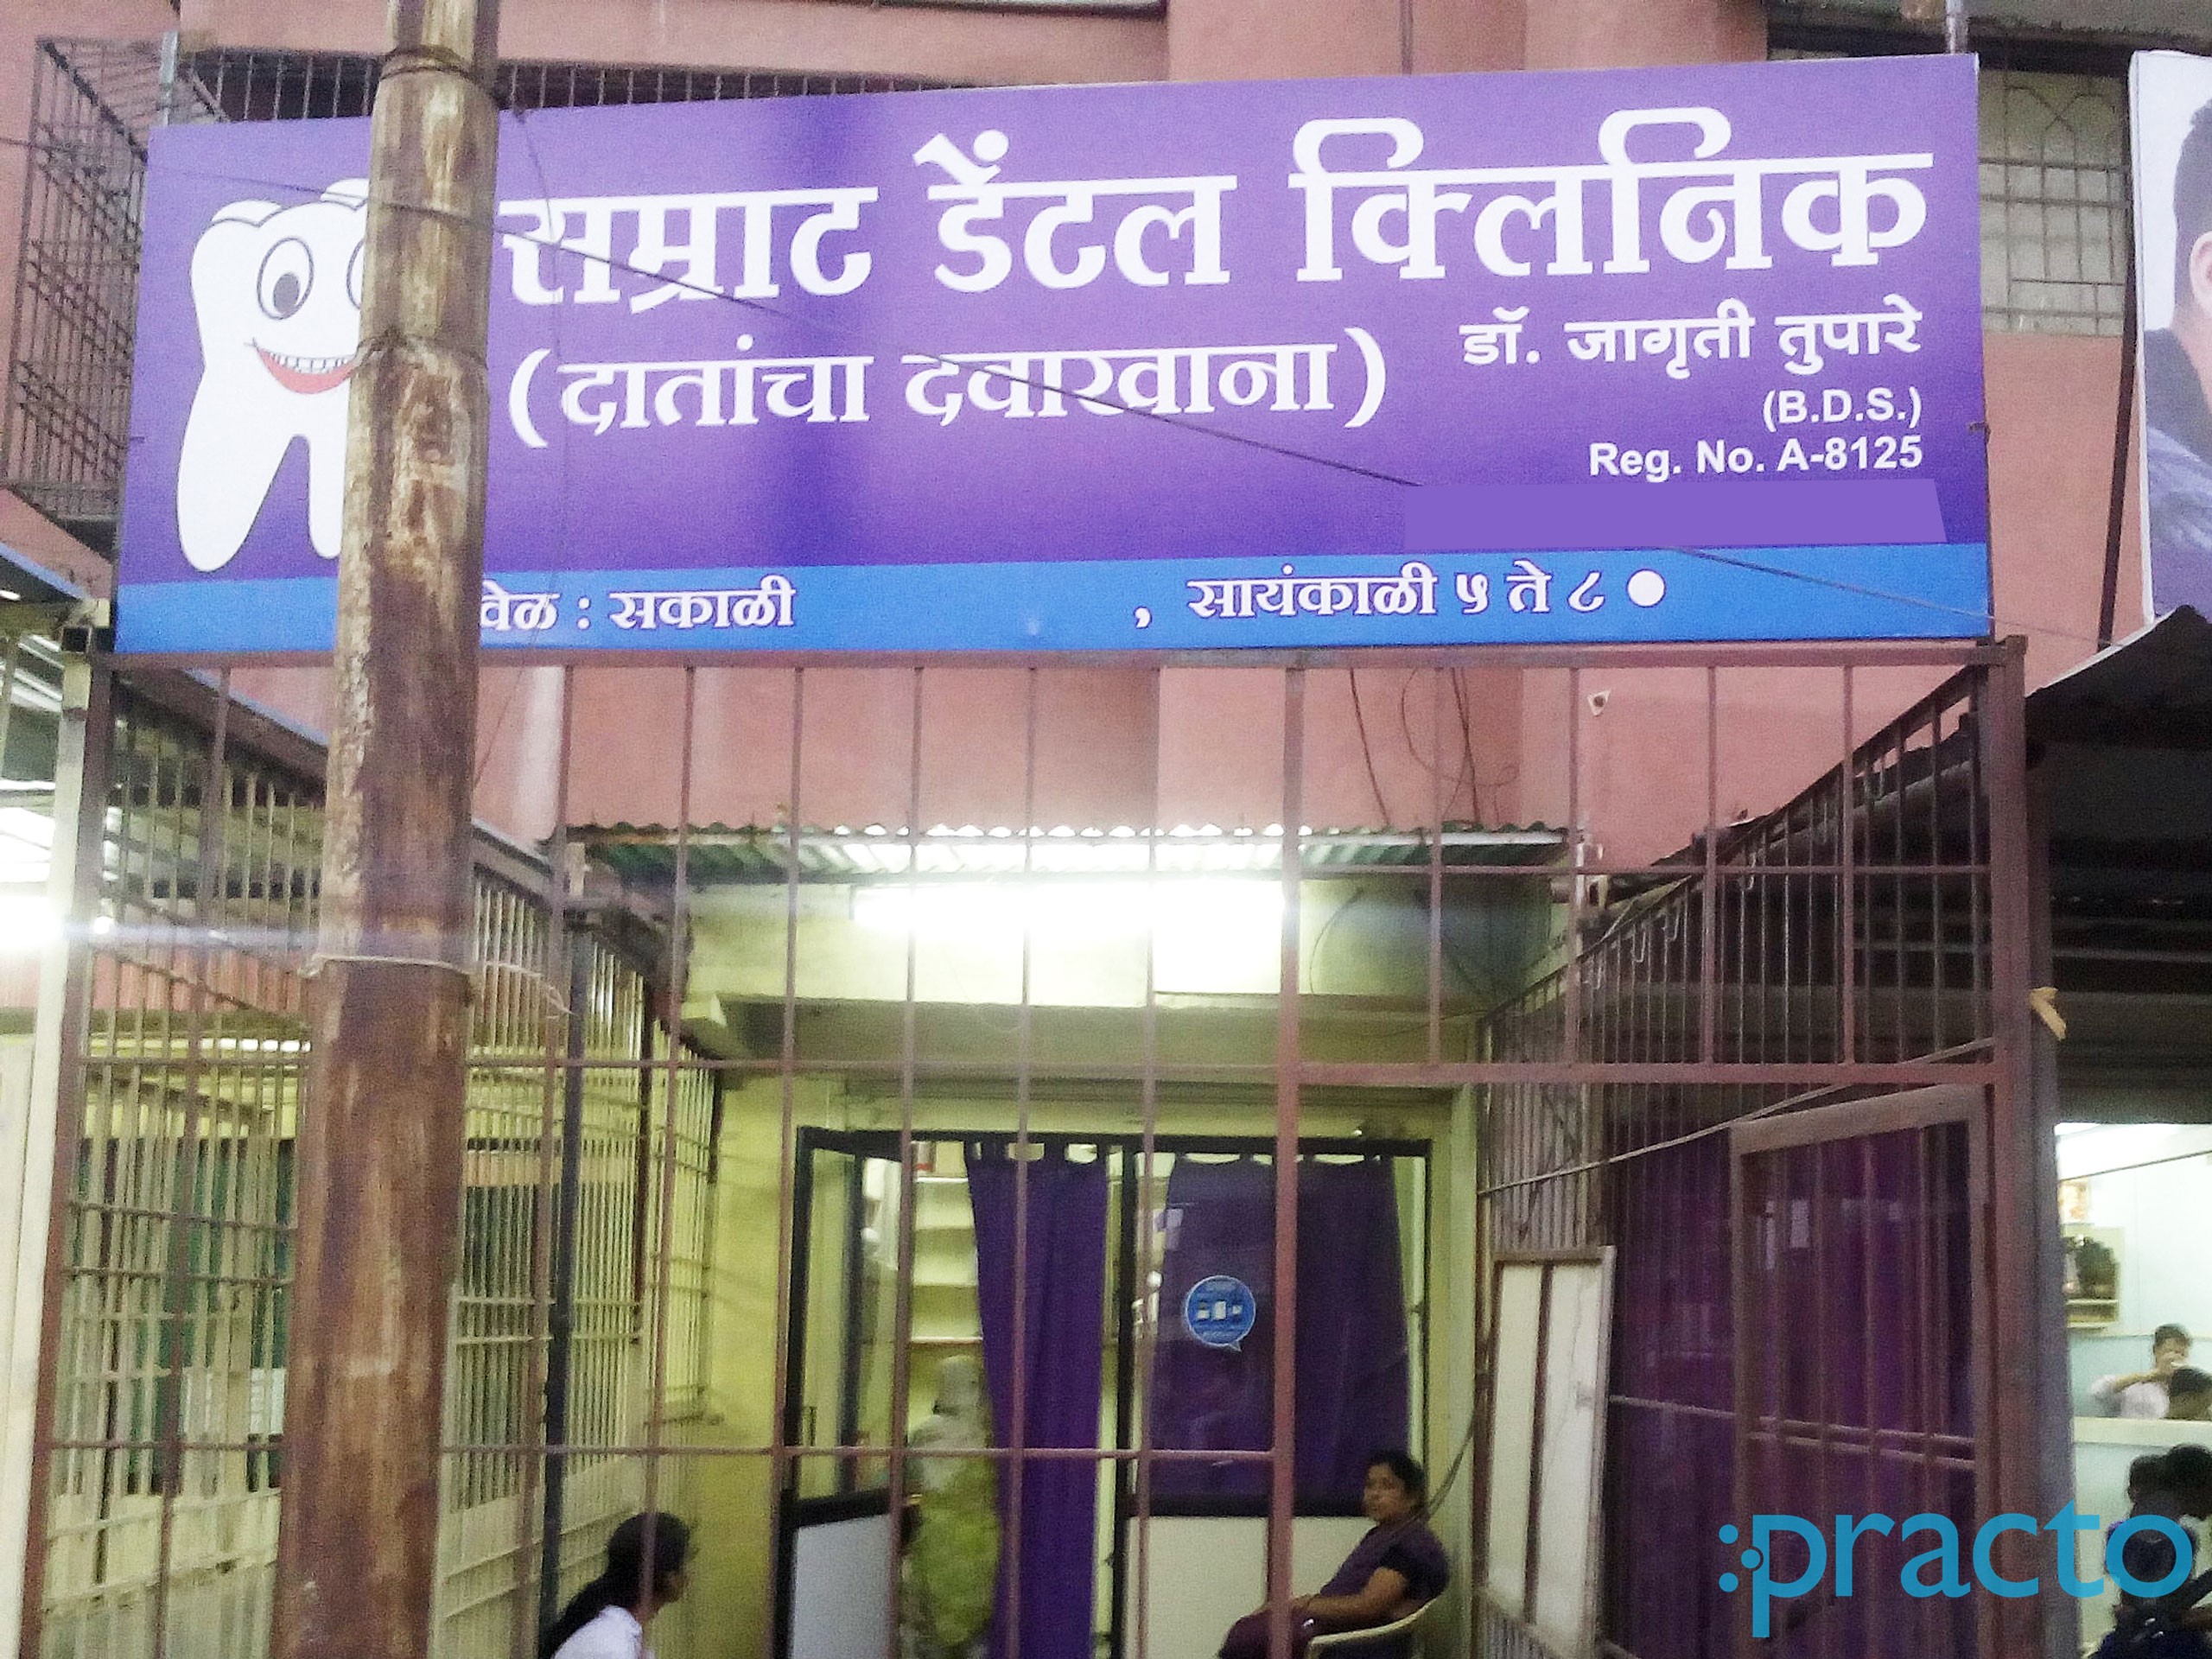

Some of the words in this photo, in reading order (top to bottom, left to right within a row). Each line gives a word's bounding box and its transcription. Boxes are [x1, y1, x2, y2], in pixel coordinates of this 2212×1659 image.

[499, 187, 880, 314] सम्राट
[912, 129, 1238, 293] डेंटल
[1287, 106, 1934, 283] क्लिनिक
[1459, 305, 1540, 365] डॉ.
[1563, 297, 1757, 380] जागृती
[1774, 293, 1923, 376] तुपारे
[1763, 386, 1922, 433] (B.D.S.)
[1589, 442, 1681, 483] Reg.
[1697, 439, 1764, 474] No.
[1777, 435, 1923, 472] A-8125
[608, 575, 797, 629] सकाळी
[1186, 562, 1438, 618] सायंकाळी
[1456, 574, 1488, 613] ५
[1506, 560, 1552, 613] ते
[1568, 572, 1605, 612] ८
